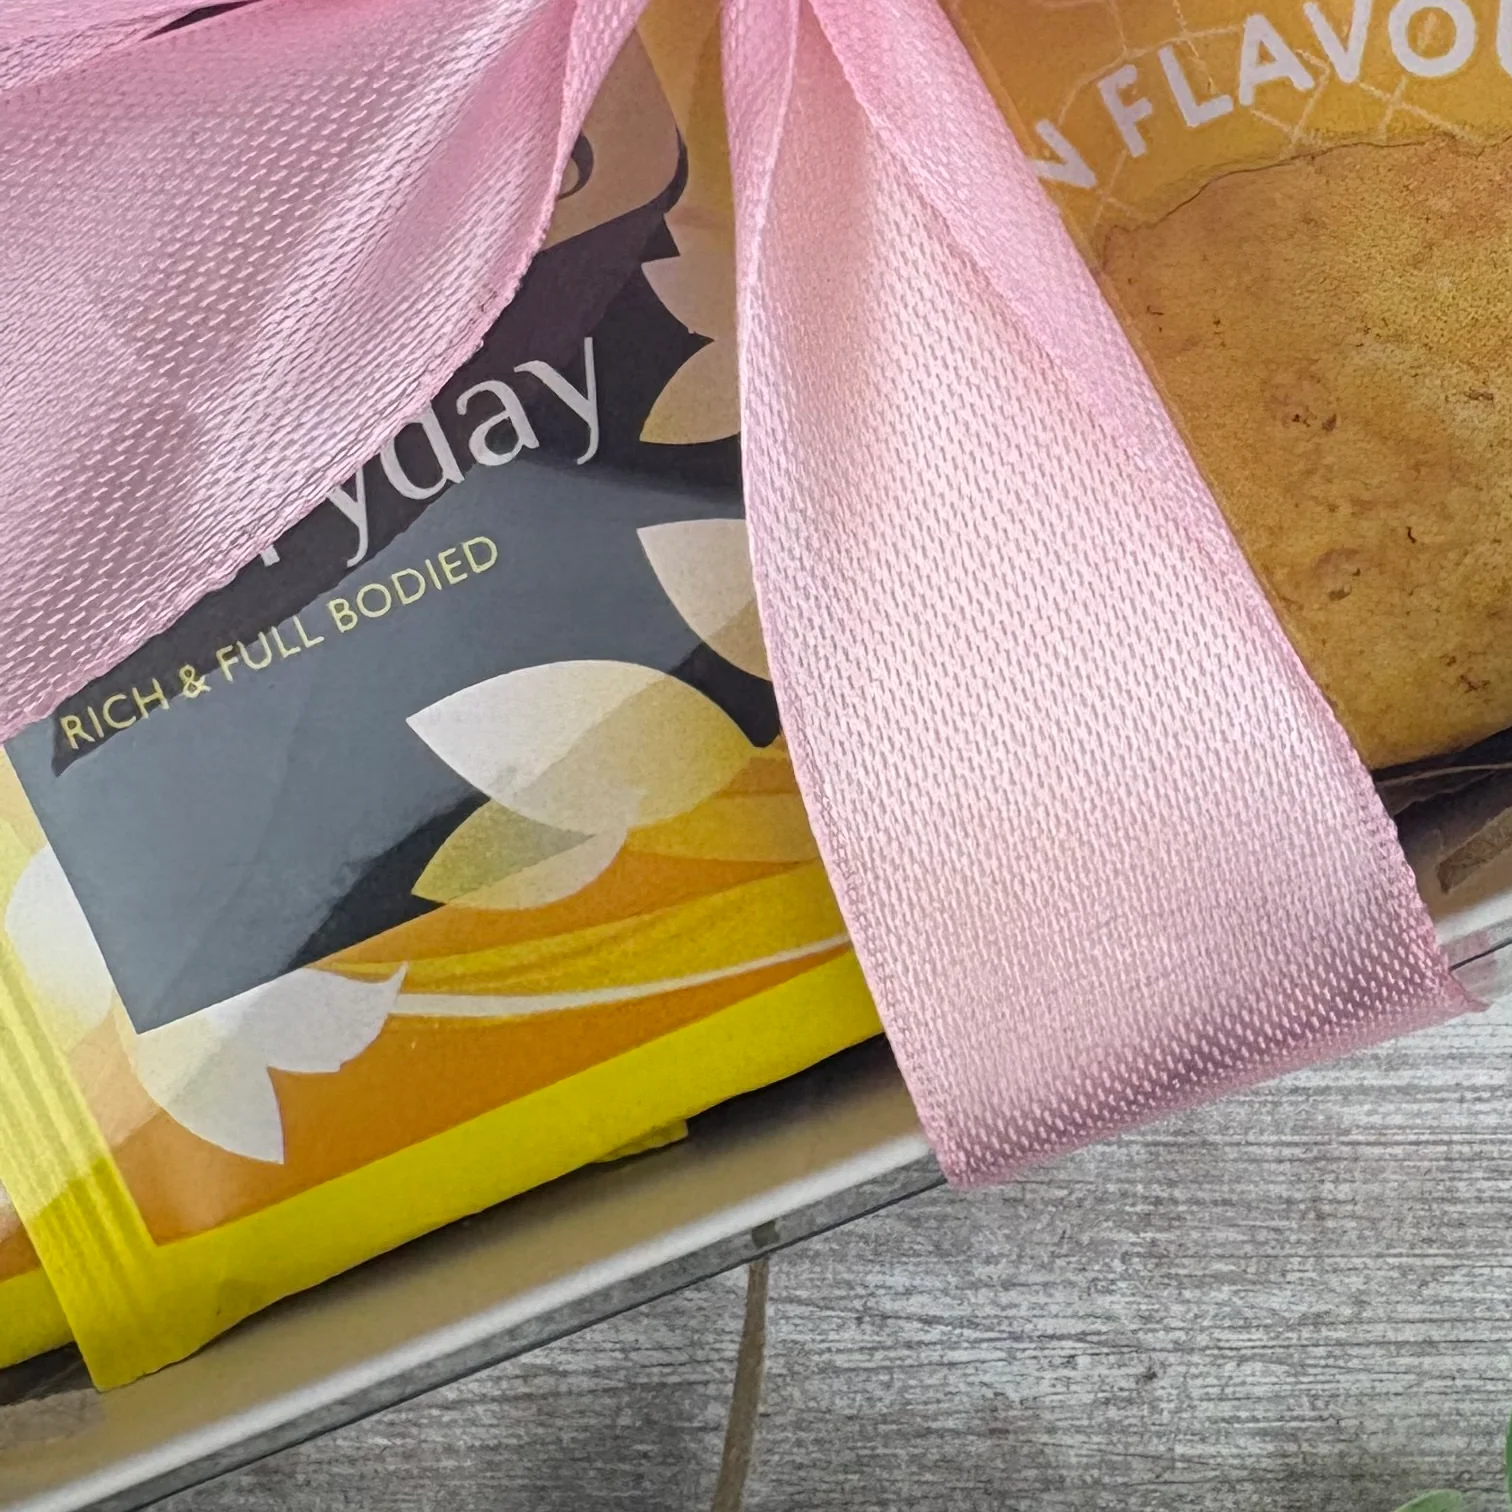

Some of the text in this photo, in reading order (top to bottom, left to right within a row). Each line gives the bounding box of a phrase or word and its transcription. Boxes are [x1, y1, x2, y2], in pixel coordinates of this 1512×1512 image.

[260, 337, 601, 568] yday
[60, 535, 499, 750] RICH & FULL BODIED
